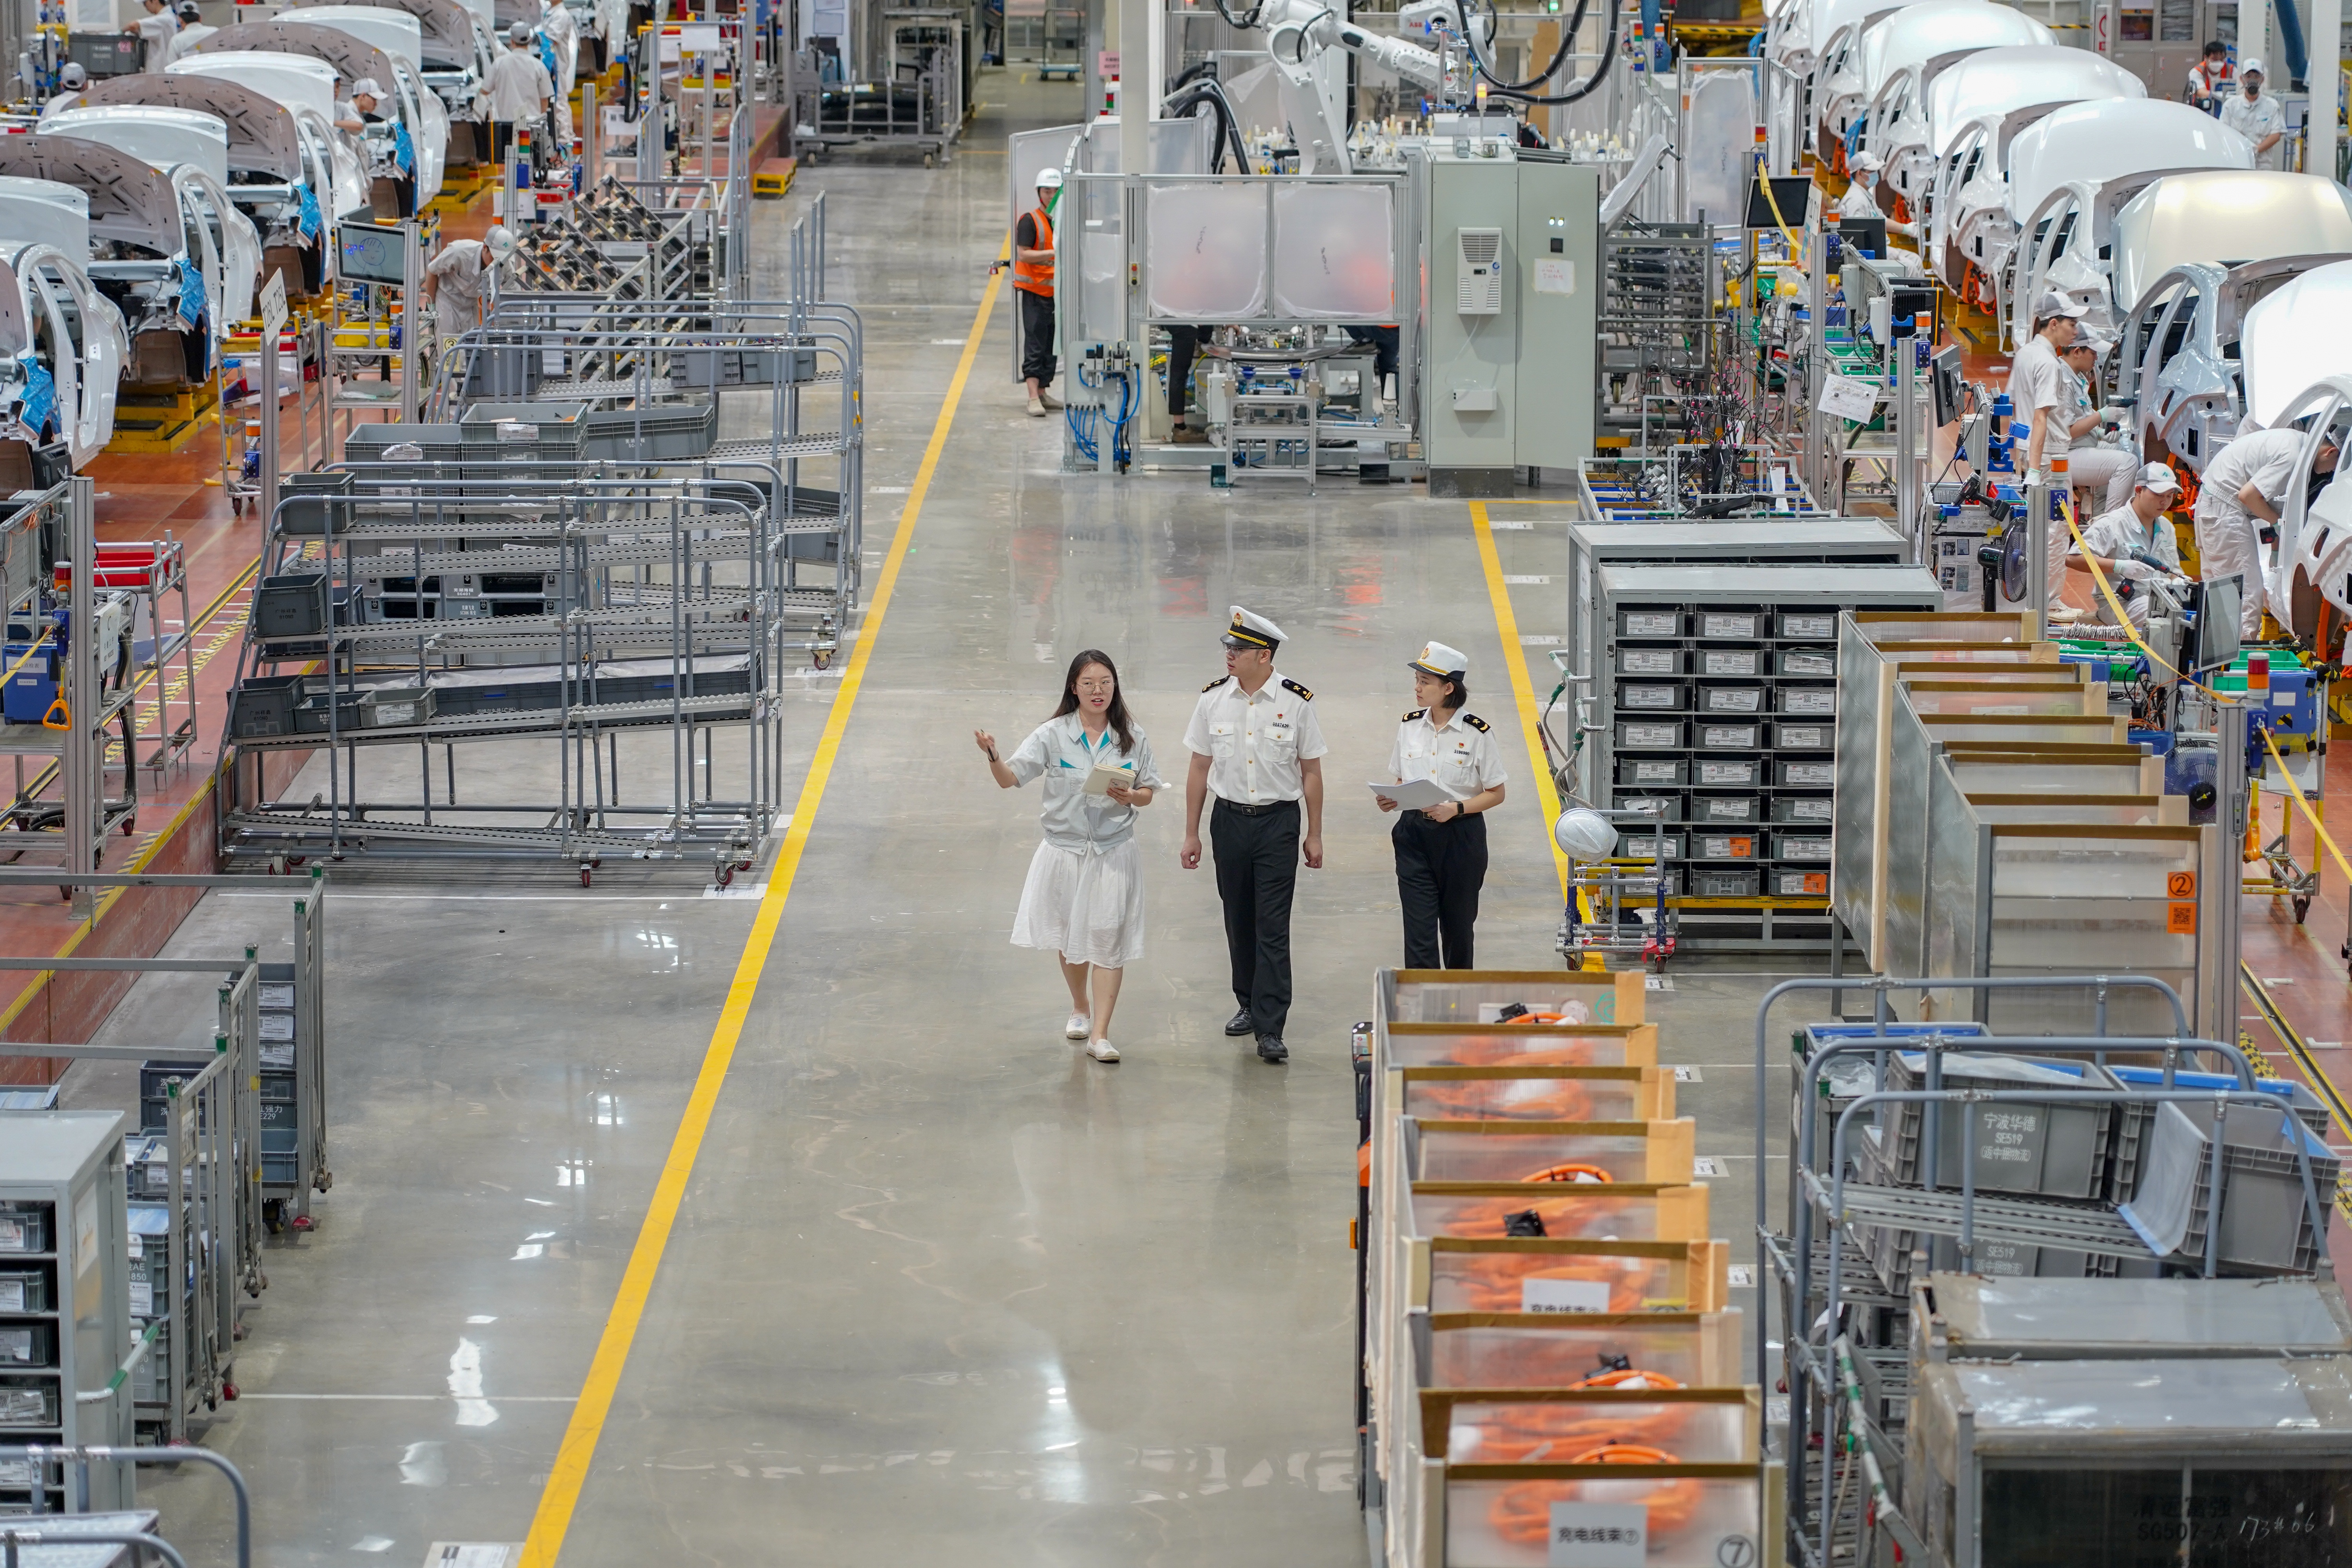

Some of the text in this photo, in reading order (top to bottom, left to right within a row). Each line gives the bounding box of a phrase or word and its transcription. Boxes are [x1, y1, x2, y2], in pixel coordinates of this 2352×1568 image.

[262, 284, 286, 330] T26L T25L
[107, 615, 112, 631] C
[1984, 1111, 2037, 1132] 宁波华德
[1994, 1131, 2024, 1145] SE519
[1987, 1245, 2015, 1259] SE519
